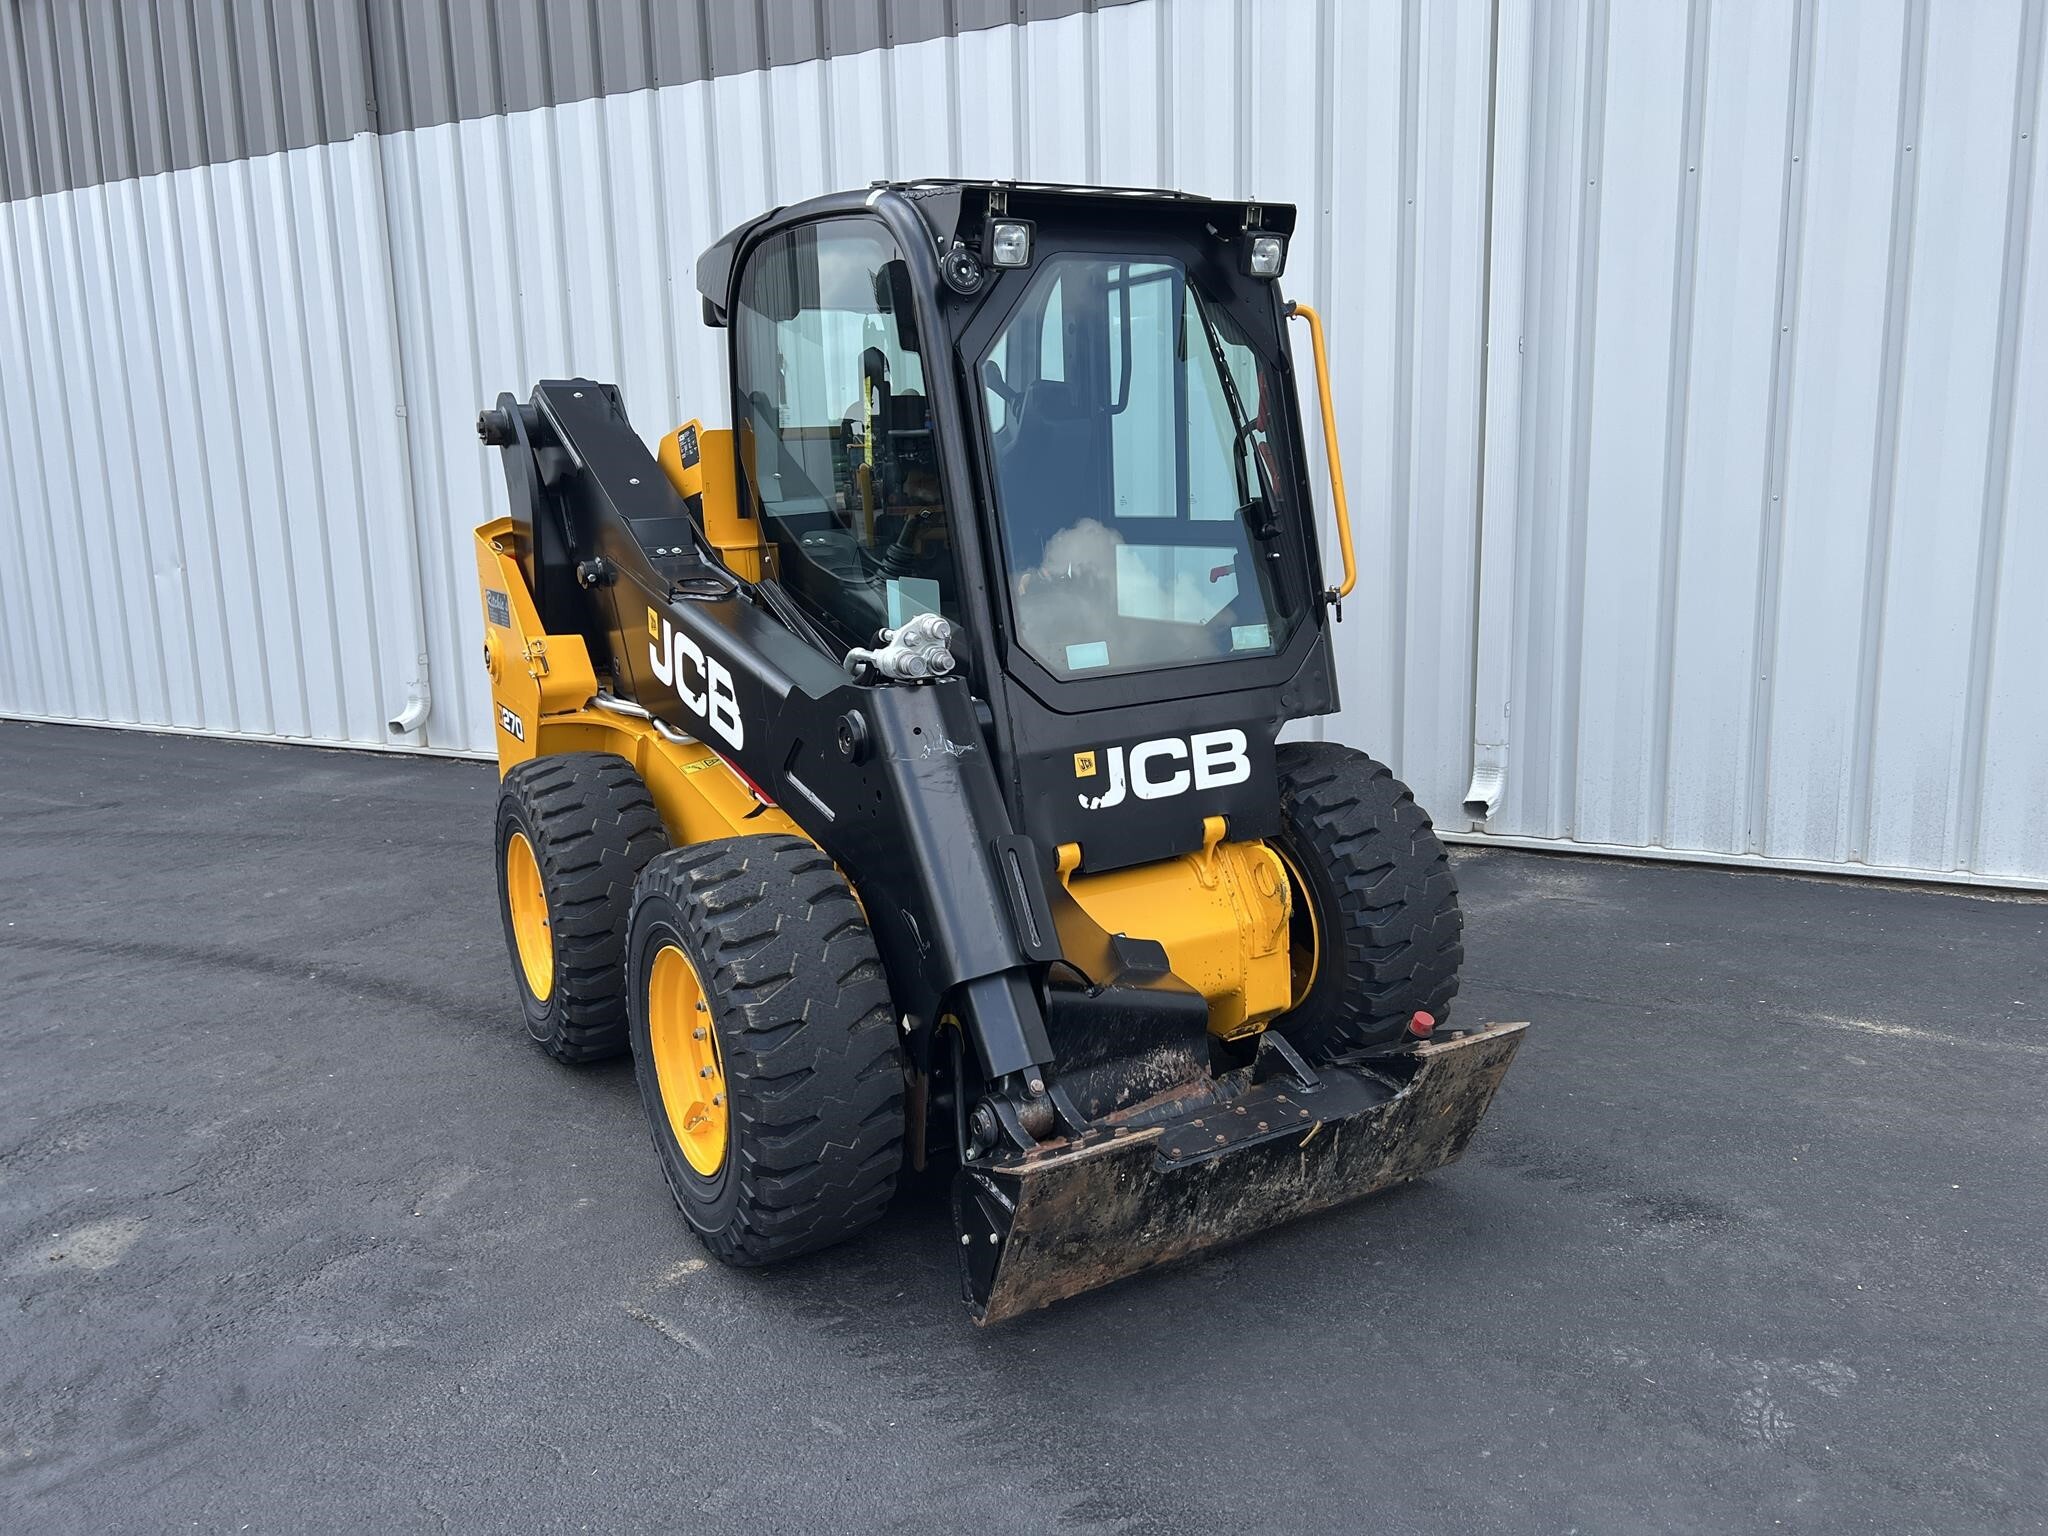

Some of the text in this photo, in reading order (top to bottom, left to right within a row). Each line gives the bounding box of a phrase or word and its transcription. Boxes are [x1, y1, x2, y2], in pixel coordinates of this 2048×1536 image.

[502, 707, 524, 740] 270
[649, 618, 743, 751] JCB
[1078, 728, 1251, 810] JCB
